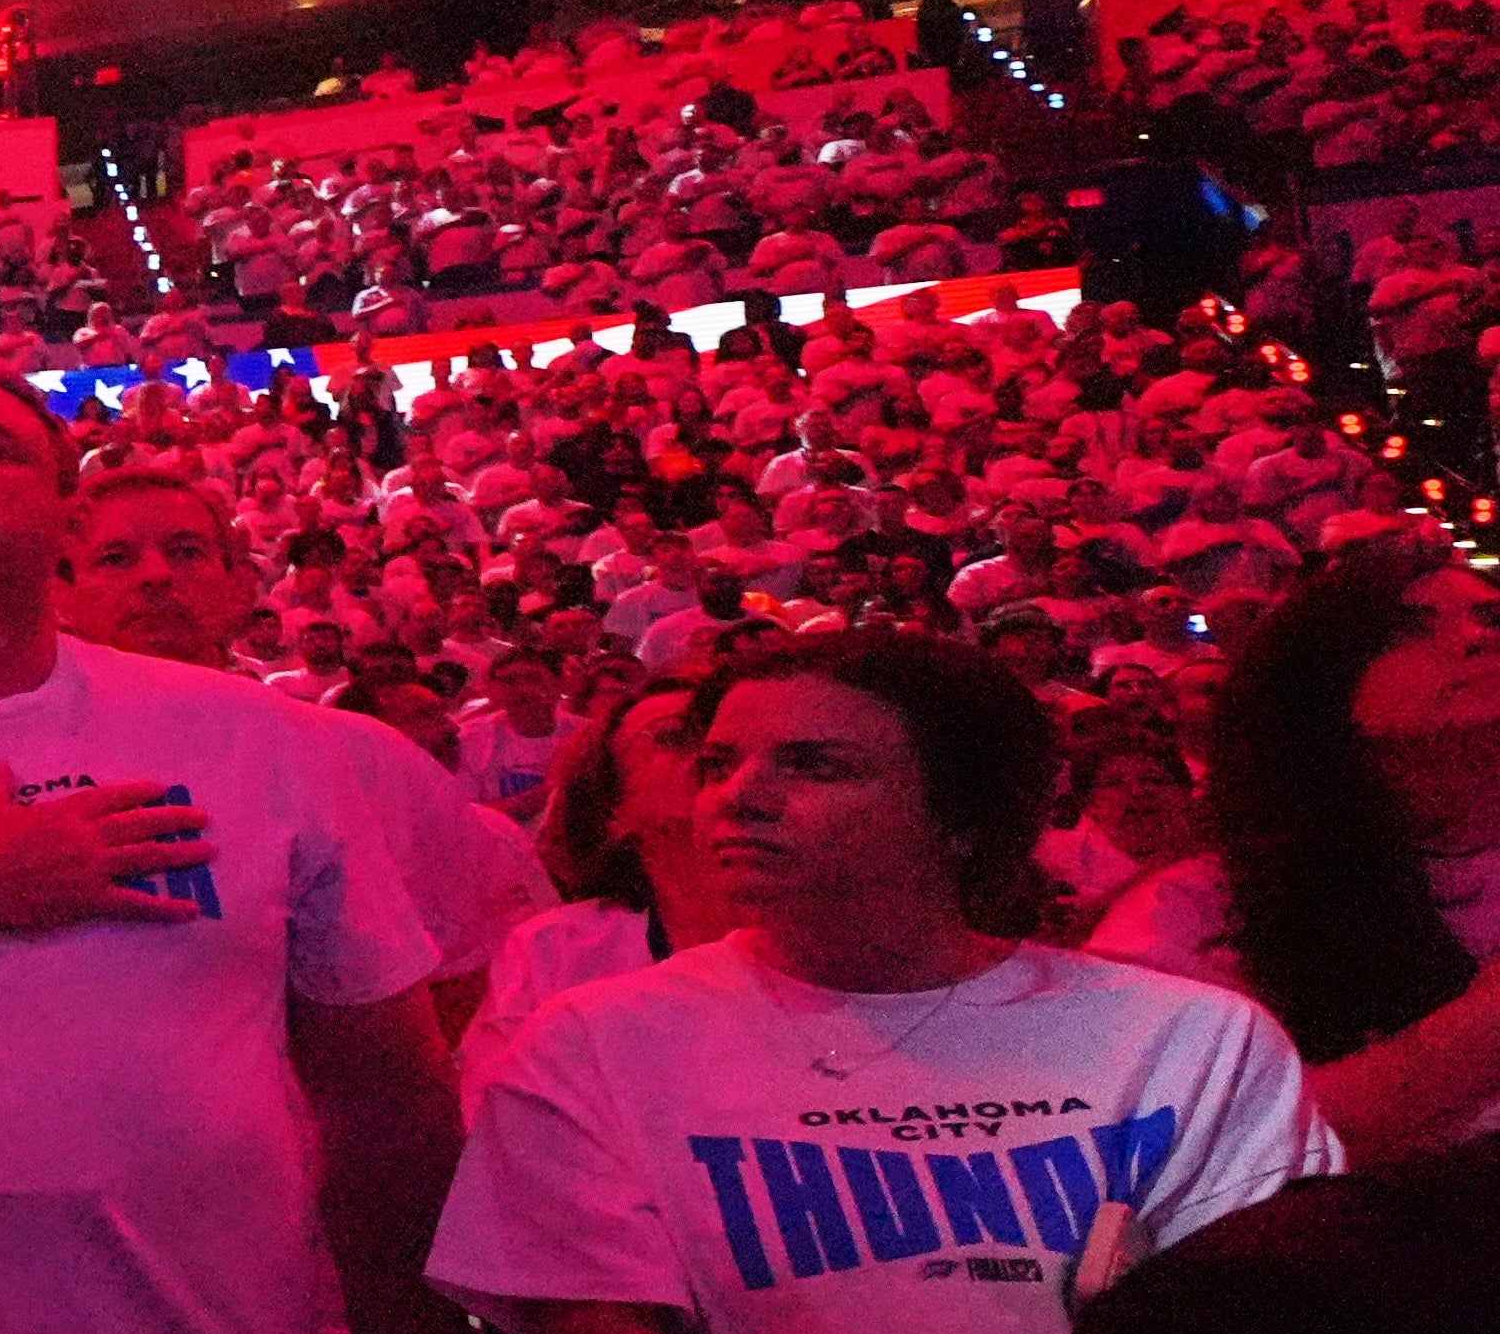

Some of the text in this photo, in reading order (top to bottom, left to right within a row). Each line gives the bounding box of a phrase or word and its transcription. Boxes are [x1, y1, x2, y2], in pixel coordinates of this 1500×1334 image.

[800, 1097, 1092, 1127] OKLAHOMA
[891, 1121, 1003, 1141] CITY
[688, 1105, 1177, 1290] THUND
